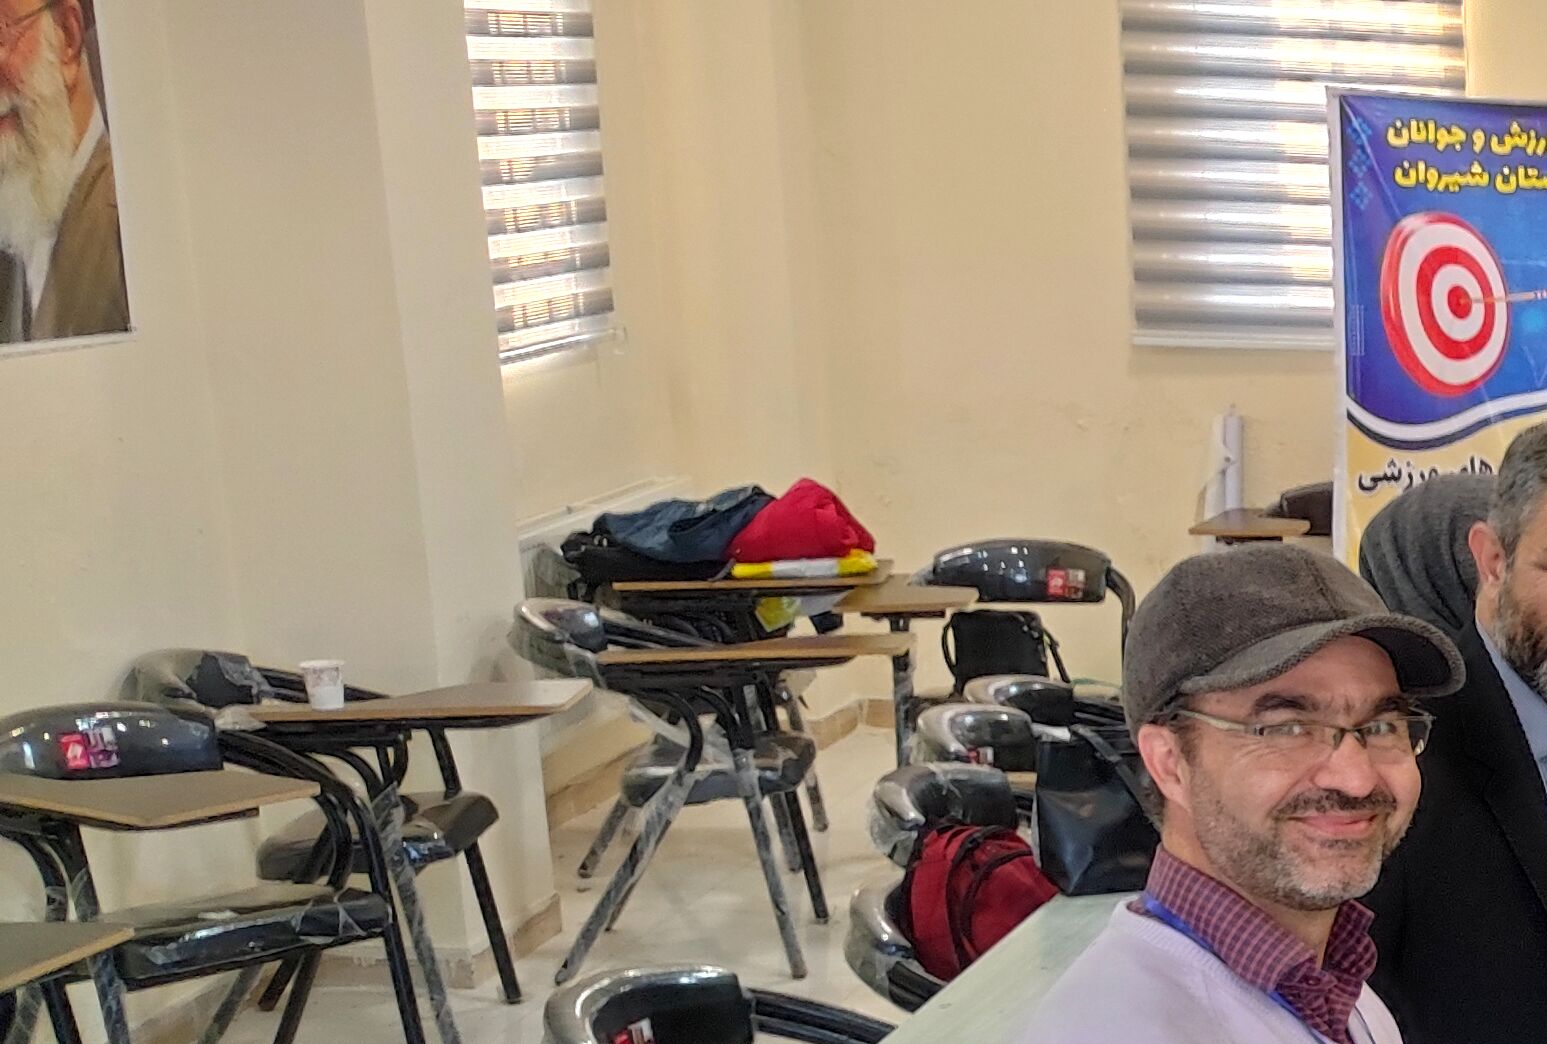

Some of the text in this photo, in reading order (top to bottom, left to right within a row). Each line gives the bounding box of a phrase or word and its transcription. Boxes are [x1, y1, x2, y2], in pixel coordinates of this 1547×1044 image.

[1386, 118, 1467, 152] جوانان
[1472, 128, 1486, 154] و
[1394, 159, 1490, 193] شیروان
